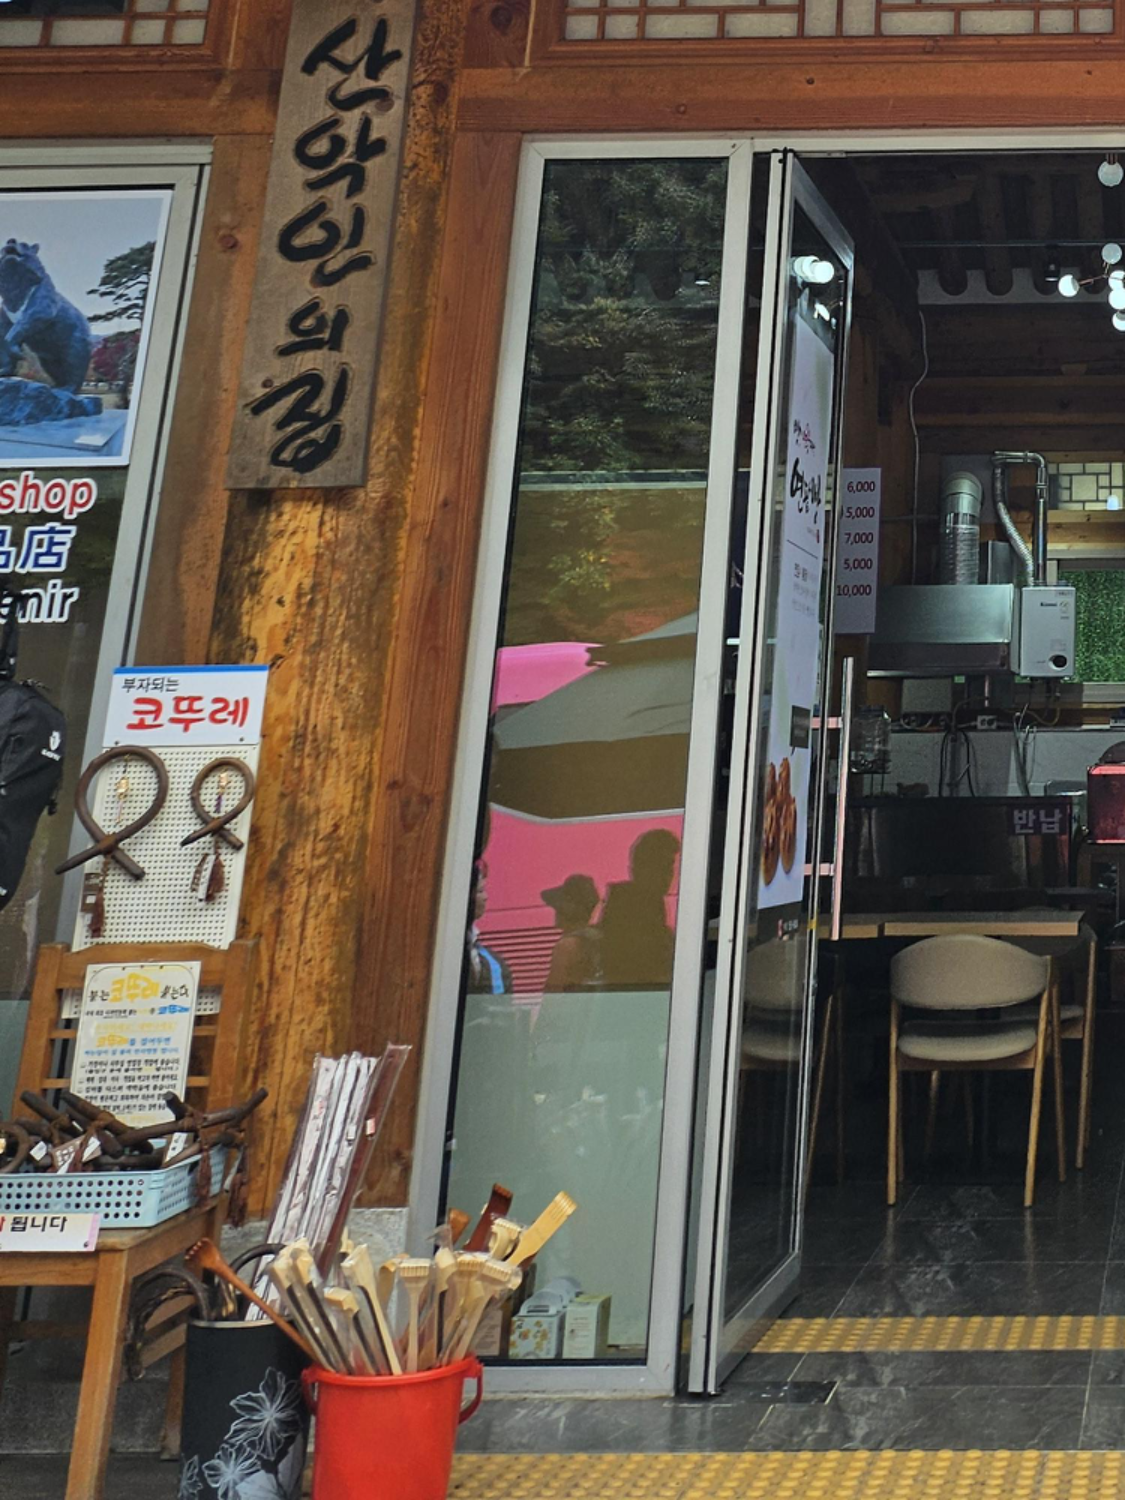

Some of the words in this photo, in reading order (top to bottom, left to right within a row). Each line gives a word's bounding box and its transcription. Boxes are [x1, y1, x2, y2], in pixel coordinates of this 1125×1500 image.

[846, 480, 876, 493] 6,000
[845, 506, 875, 519] 5,000
[844, 532, 874, 546] 7,000
[843, 558, 873, 572] 5,000
[836, 584, 872, 598] 10,000
[121, 676, 180, 693] 부자되는
[126, 695, 250, 733] 코뚜레
[1013, 808, 1063, 834] 반납
[10, 1215, 69, 1233] 됩니다
